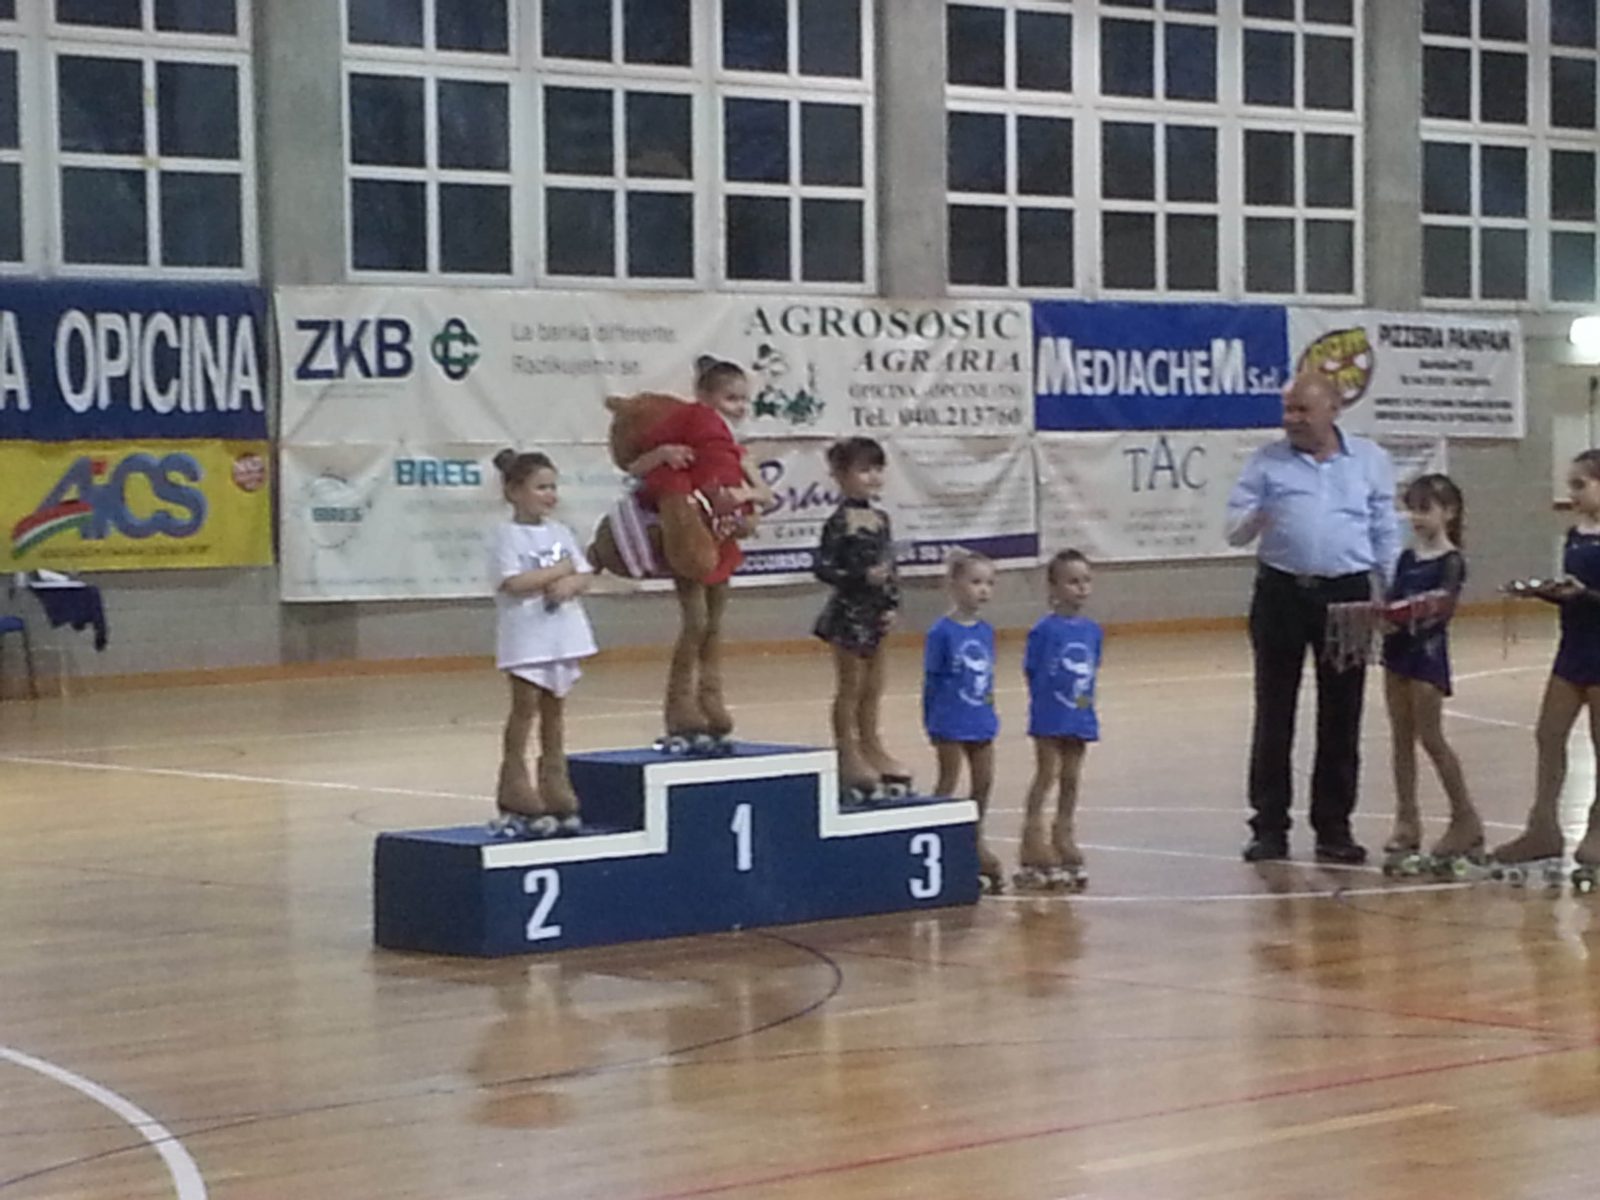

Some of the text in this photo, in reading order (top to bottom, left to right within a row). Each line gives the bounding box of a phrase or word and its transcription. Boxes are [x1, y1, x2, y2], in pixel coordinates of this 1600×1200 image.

[295, 318, 414, 381] ZKB
[745, 305, 1021, 340] AGROSOSIC
[56, 309, 264, 414] OPICINA
[853, 349, 1022, 373] AGRARIA
[396, 459, 481, 487] BREG
[1123, 436, 1208, 492] TAC
[731, 803, 751, 871] 1
[908, 833, 943, 898] 3
[523, 868, 562, 940] 2
